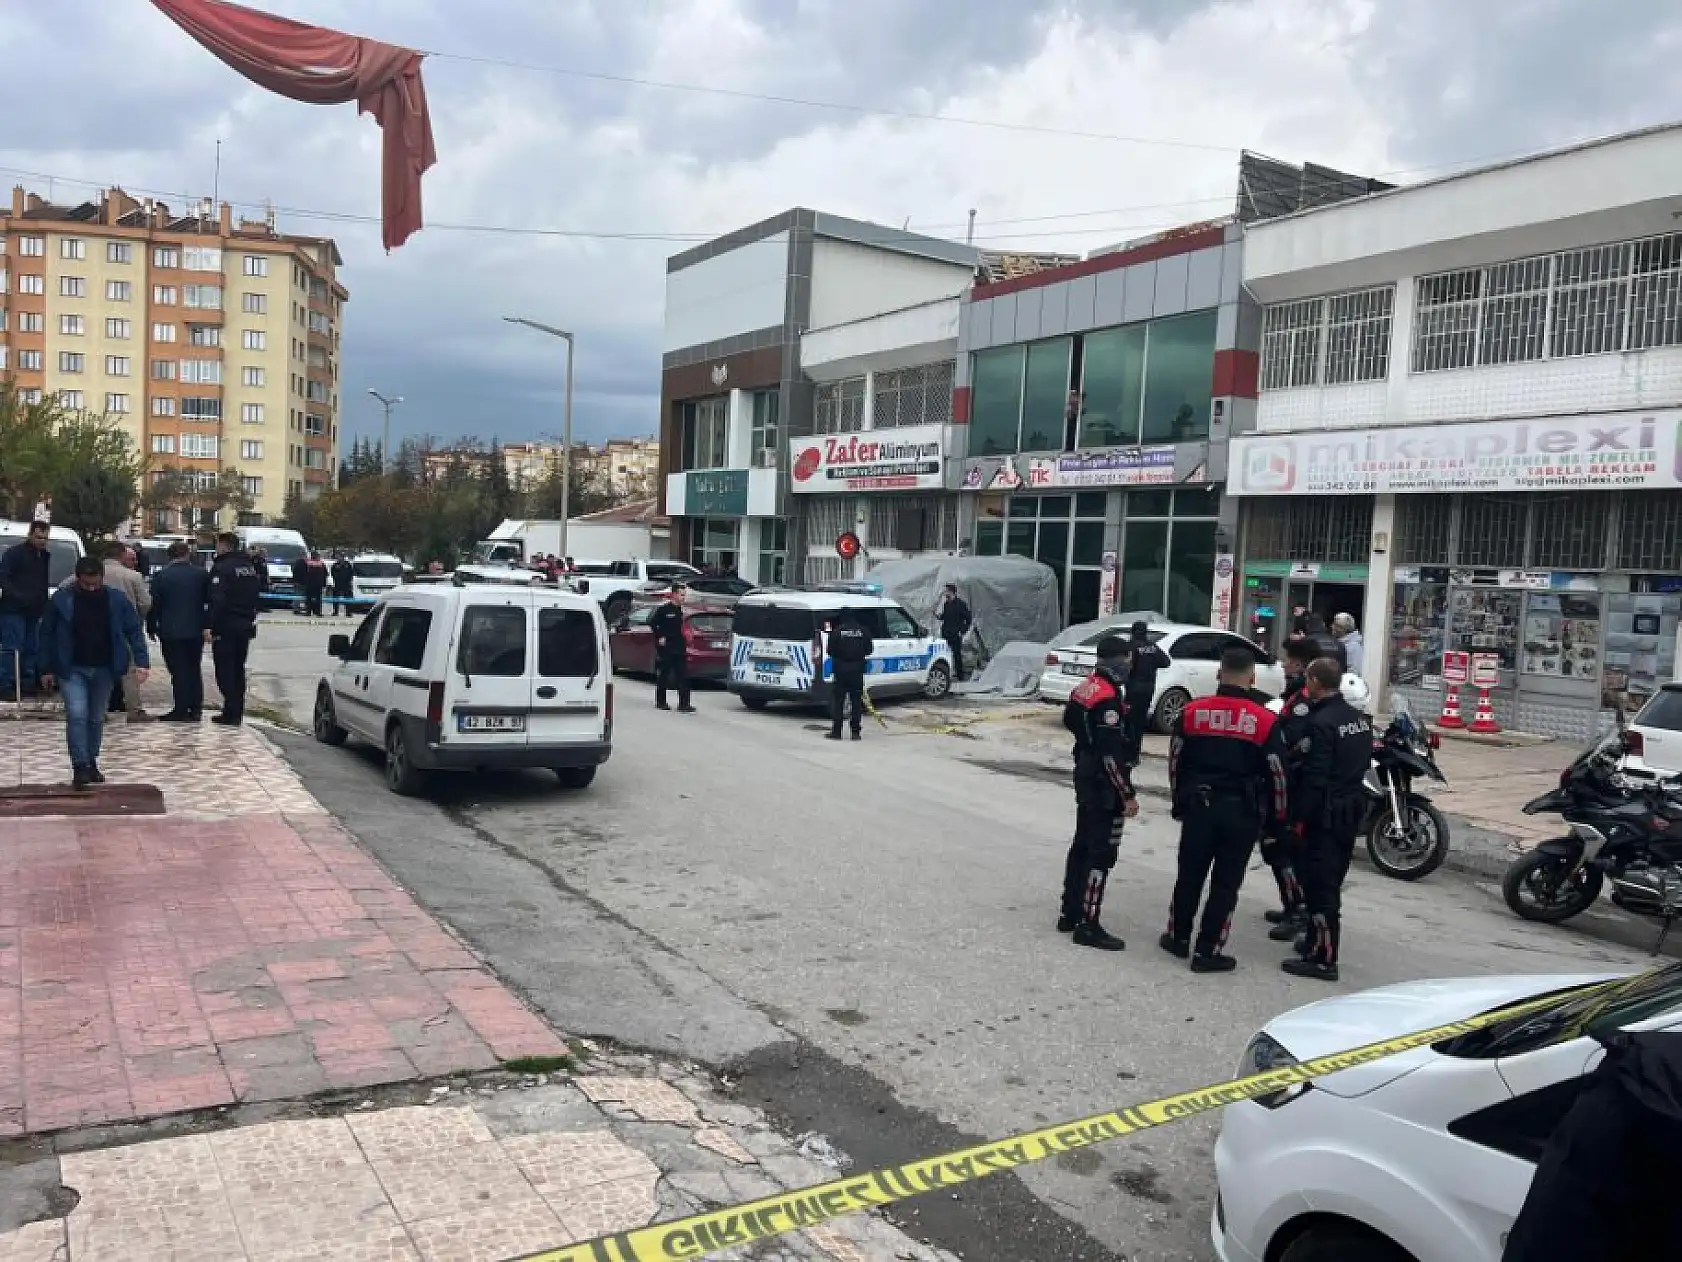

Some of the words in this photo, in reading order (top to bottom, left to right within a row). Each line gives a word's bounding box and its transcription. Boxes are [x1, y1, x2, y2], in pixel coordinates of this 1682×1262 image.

[826, 436, 878, 464] Zafer
[1308, 417, 1656, 465] mikaplexi
[1589, 463, 1656, 474] REKLAM
[1195, 708, 1257, 734] POLİS
